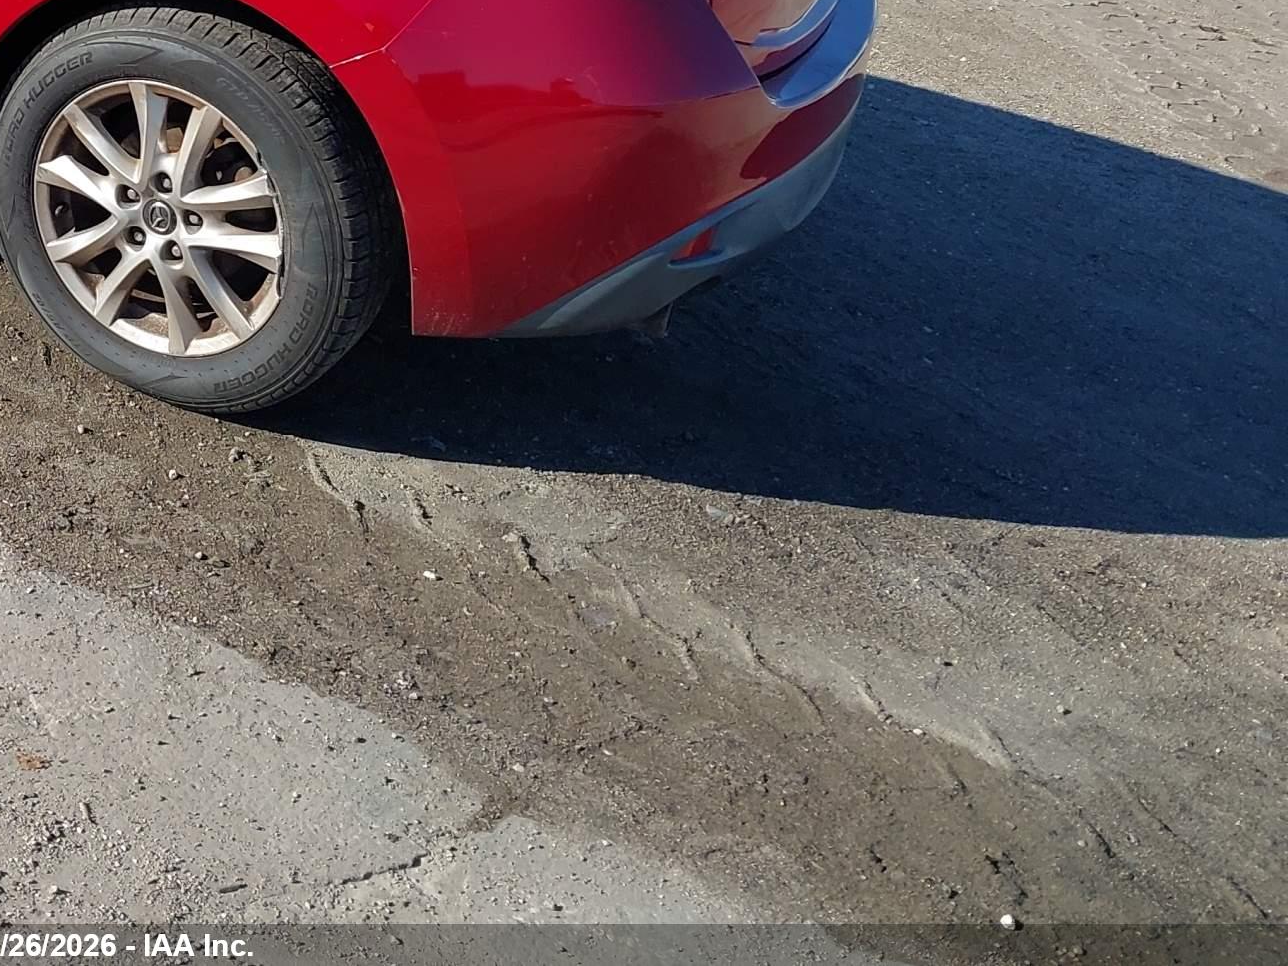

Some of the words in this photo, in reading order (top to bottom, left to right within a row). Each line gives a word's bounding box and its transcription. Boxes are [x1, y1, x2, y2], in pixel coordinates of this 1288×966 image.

[23, 52, 93, 109] HUGGER
[289, 282, 319, 344] ROAD
[213, 342, 292, 393] HUGGER
